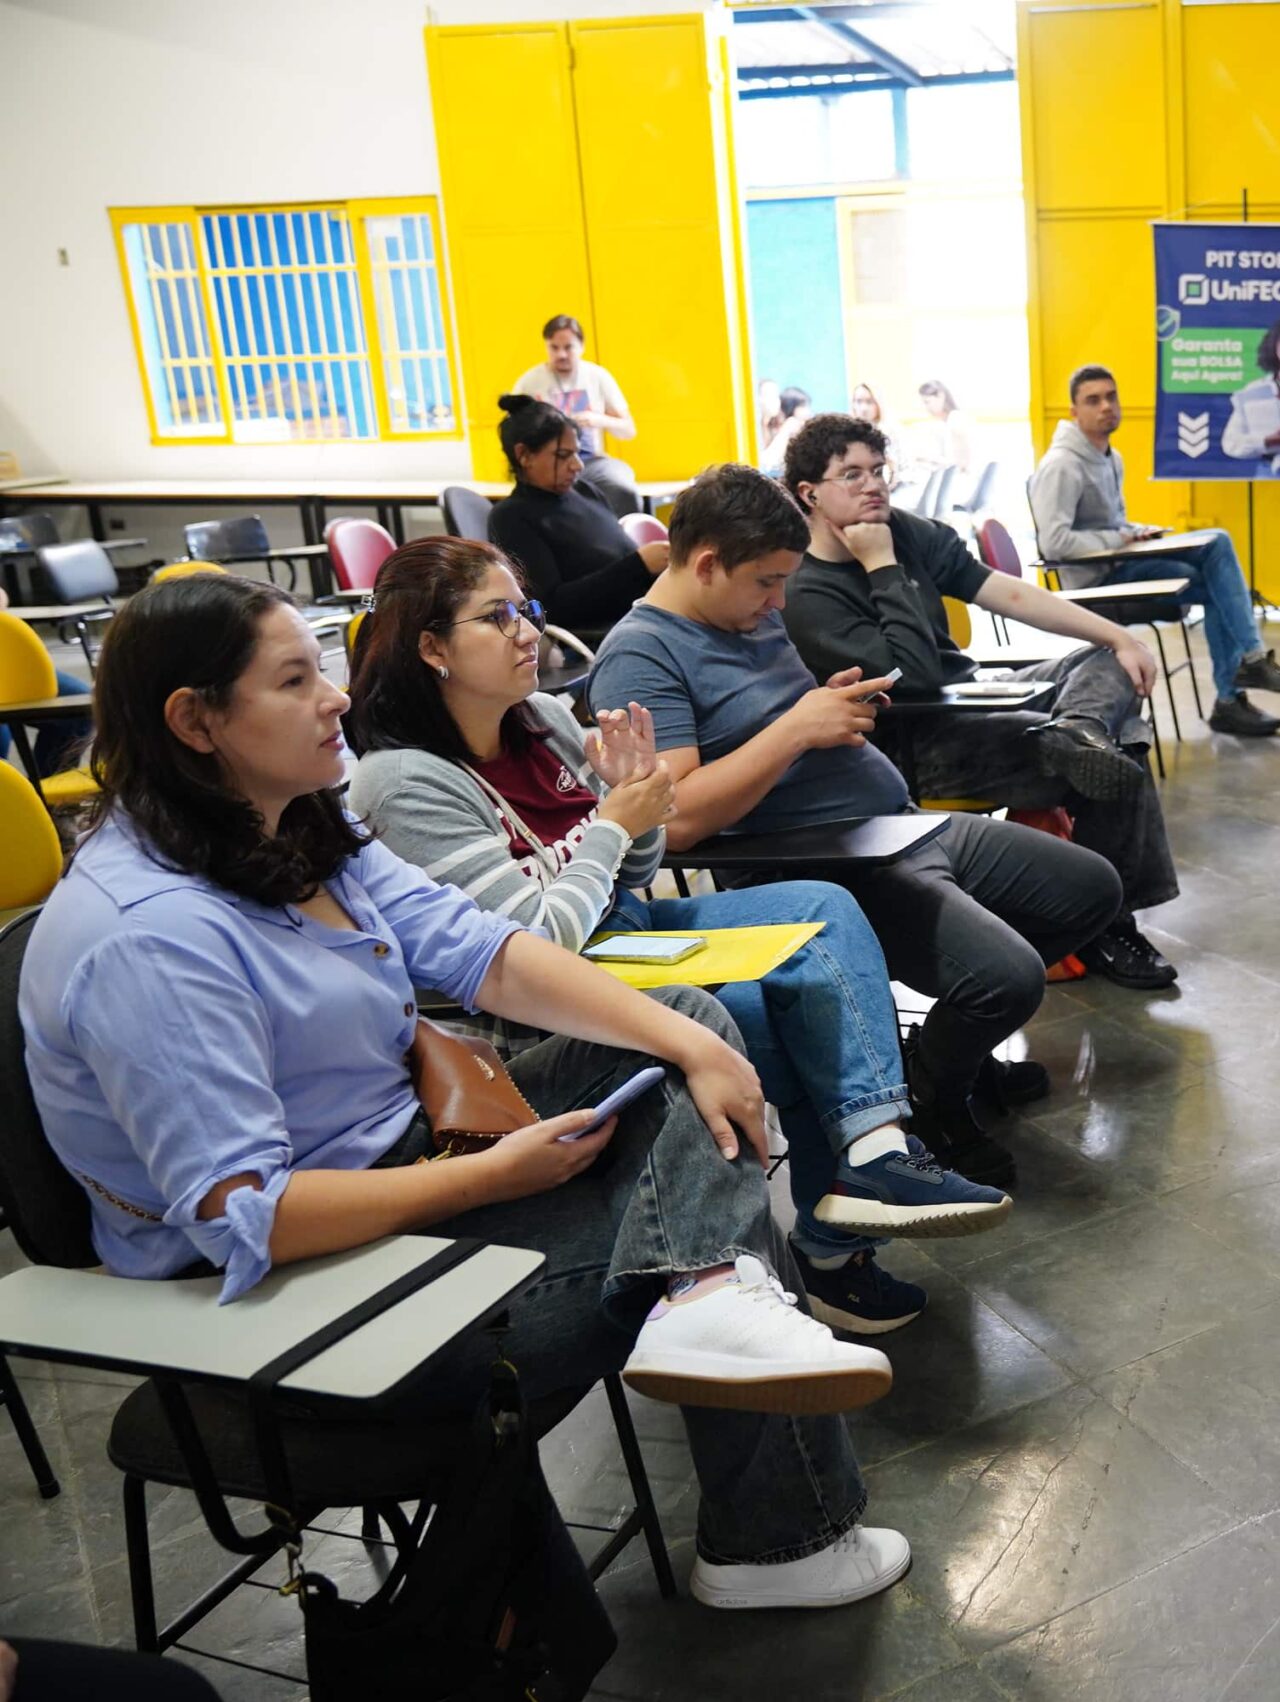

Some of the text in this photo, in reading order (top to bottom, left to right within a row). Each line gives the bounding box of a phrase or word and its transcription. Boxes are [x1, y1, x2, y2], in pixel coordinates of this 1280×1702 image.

[1205, 250, 1236, 268] PIT
[1172, 338, 1243, 352] Garanta
[1200, 356, 1243, 367] BOLSA
